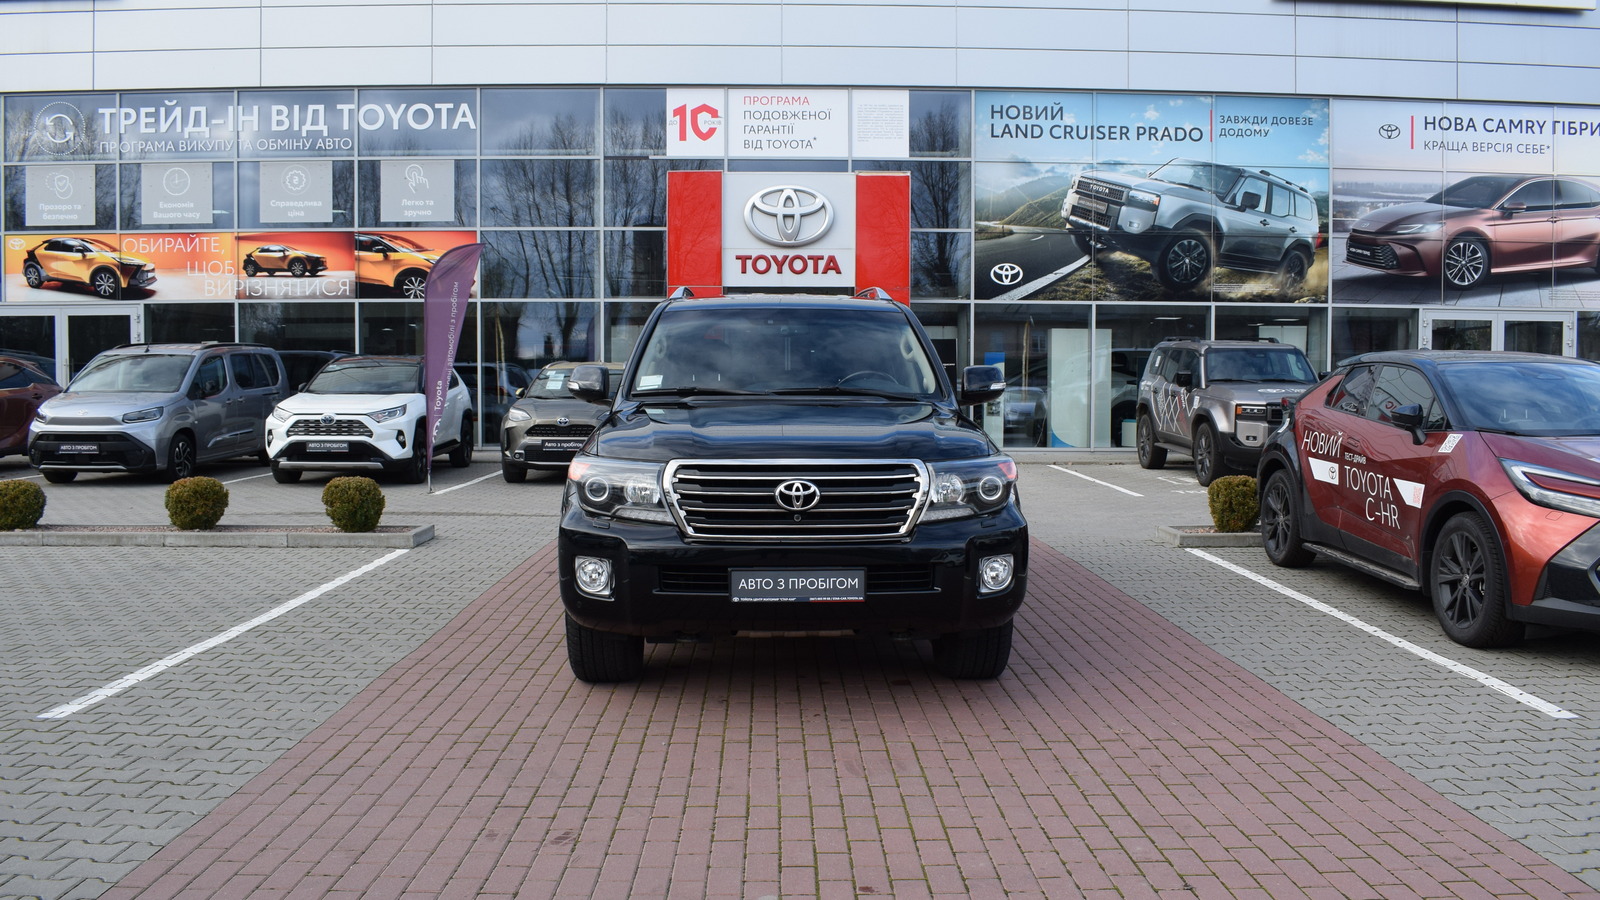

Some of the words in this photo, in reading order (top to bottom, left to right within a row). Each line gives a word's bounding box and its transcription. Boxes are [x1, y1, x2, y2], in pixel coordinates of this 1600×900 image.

[743, 96, 810, 106] ПРОГРАМА
[98, 99, 259, 138] ТРЕЙД-ІН
[271, 104, 328, 137] ВІД
[337, 103, 476, 131] TOYOTA
[743, 108, 832, 121] ПОДОВЖЕНОЇ
[991, 101, 1064, 121] НОВИЙ
[743, 123, 795, 134] ГАРАНТІЇ
[1219, 115, 1268, 126] ЗАВЖДИ
[1271, 116, 1313, 127] ДОВЕЗЕ
[1424, 115, 1477, 132] НОВА
[1482, 118, 1546, 134] CAMRY
[991, 123, 1043, 139] LAND
[1049, 124, 1130, 141] CRUISER
[1136, 126, 1203, 142] PRADO
[1219, 128, 1270, 138] ДОДОМУ
[99, 141, 175, 153] ПРОГРАМА
[179, 139, 234, 152] ВИКУПУ
[256, 138, 312, 150] ОБМІНУ
[316, 138, 352, 150] АВТО
[743, 140, 763, 151] ВІД
[1424, 140, 1468, 153] КРАЩА
[1472, 142, 1512, 153] ВЕРСІЯ
[39, 203, 72, 211] Прозоро
[270, 200, 322, 208] Справедлива
[287, 209, 304, 217] ціна
[122, 234, 225, 255] ОБИРАЙТЕ,
[187, 260, 234, 278] ЩОБ
[735, 254, 842, 275] TOYOTA
[204, 279, 350, 296] ВИРІЗНЯТИСЯ
[451, 281, 459, 318] пробігом
[434, 380, 443, 411] Toyota
[1301, 430, 1343, 458] НОВИЙ
[1344, 465, 1393, 501] TOYOTA
[1365, 497, 1400, 530] C-HR
[738, 578, 773, 590] АВТО
[777, 578, 785, 590] З
[788, 578, 859, 589] ПРОБІГОМ
